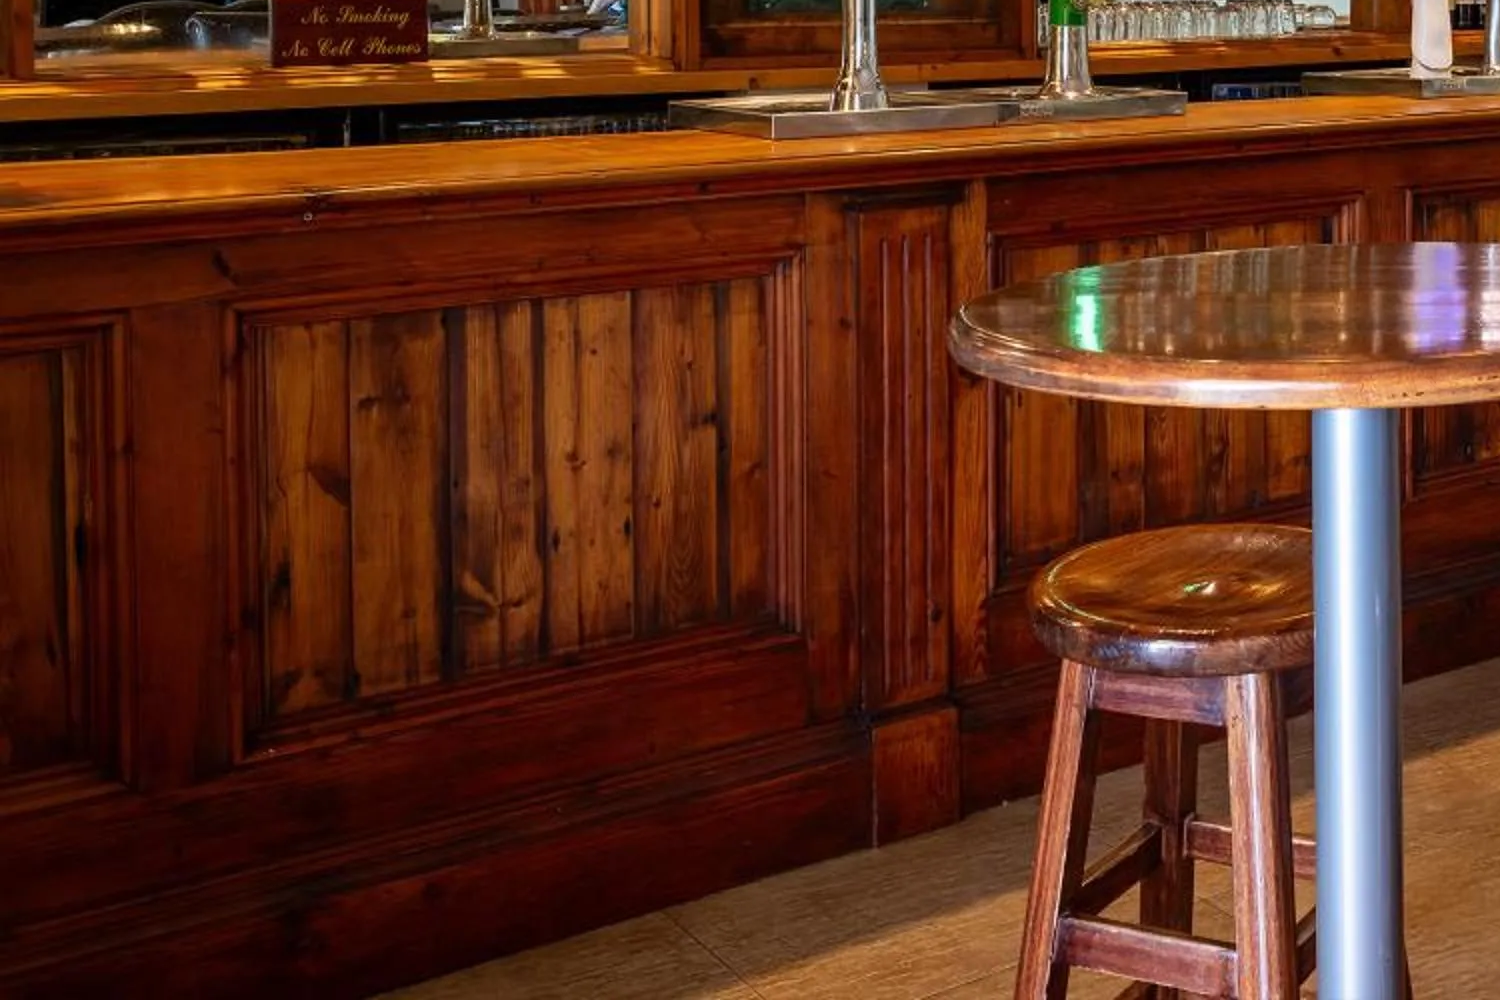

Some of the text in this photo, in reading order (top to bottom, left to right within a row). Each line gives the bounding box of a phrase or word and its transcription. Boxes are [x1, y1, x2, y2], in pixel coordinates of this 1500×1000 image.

[301, 4, 411, 30] No Smoking
[281, 36, 422, 58] No Cell Phones
